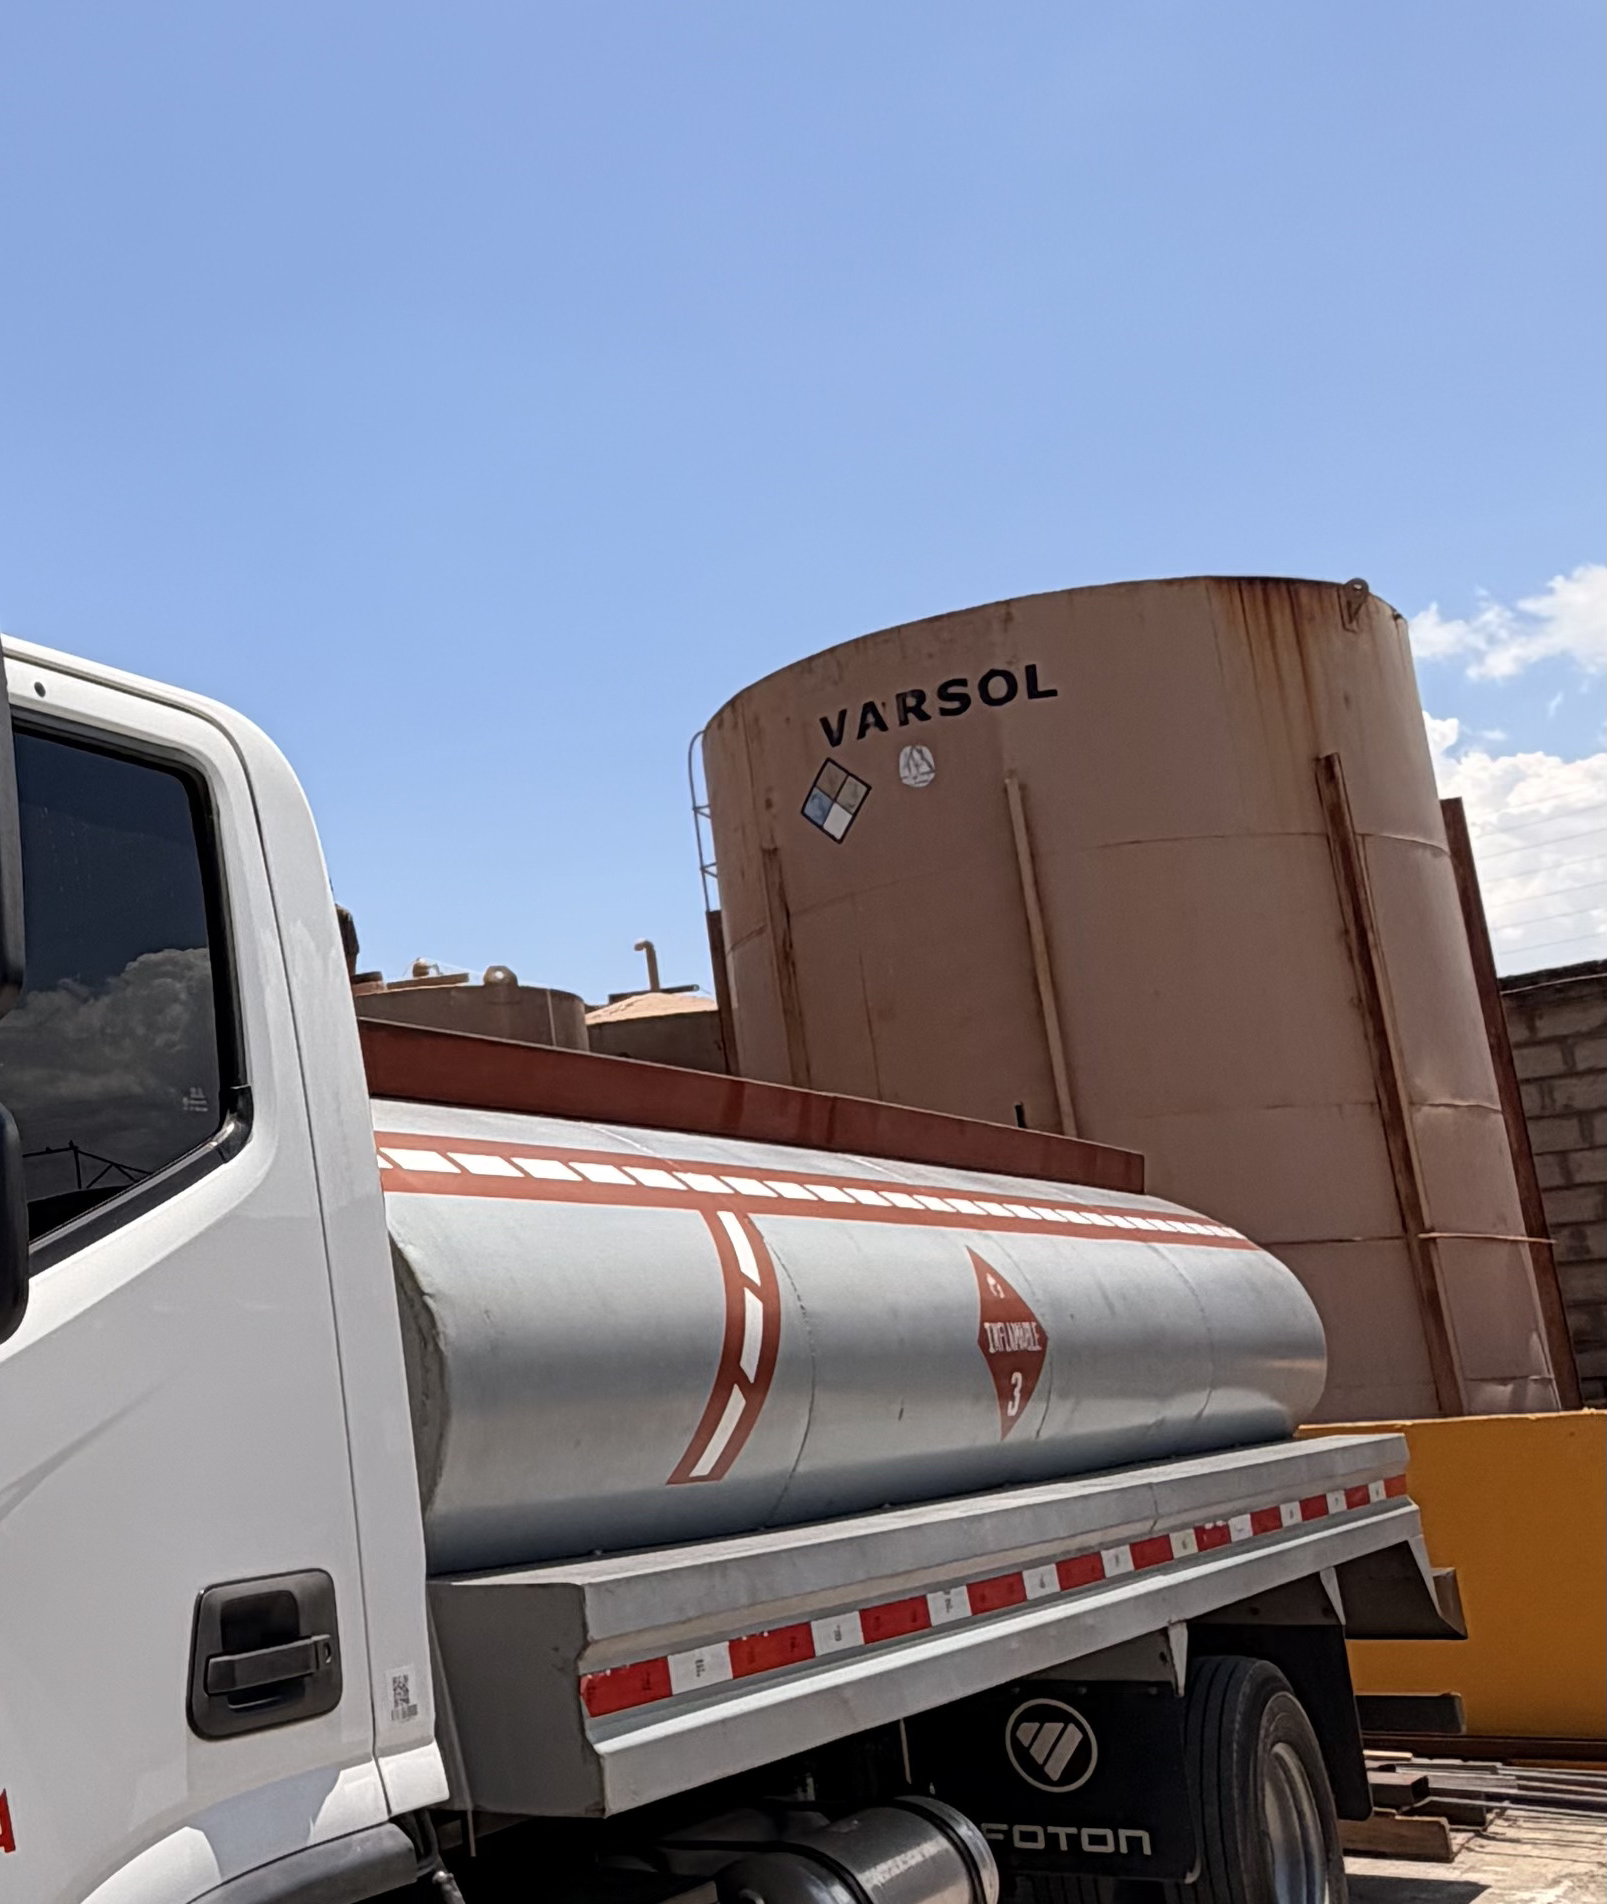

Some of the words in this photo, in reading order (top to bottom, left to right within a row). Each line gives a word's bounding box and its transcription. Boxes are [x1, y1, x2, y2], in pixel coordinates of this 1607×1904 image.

[818, 663, 1059, 748] VARSOL
[1007, 1371, 1023, 1417] 3
[980, 1822, 1152, 1856] FOTON
